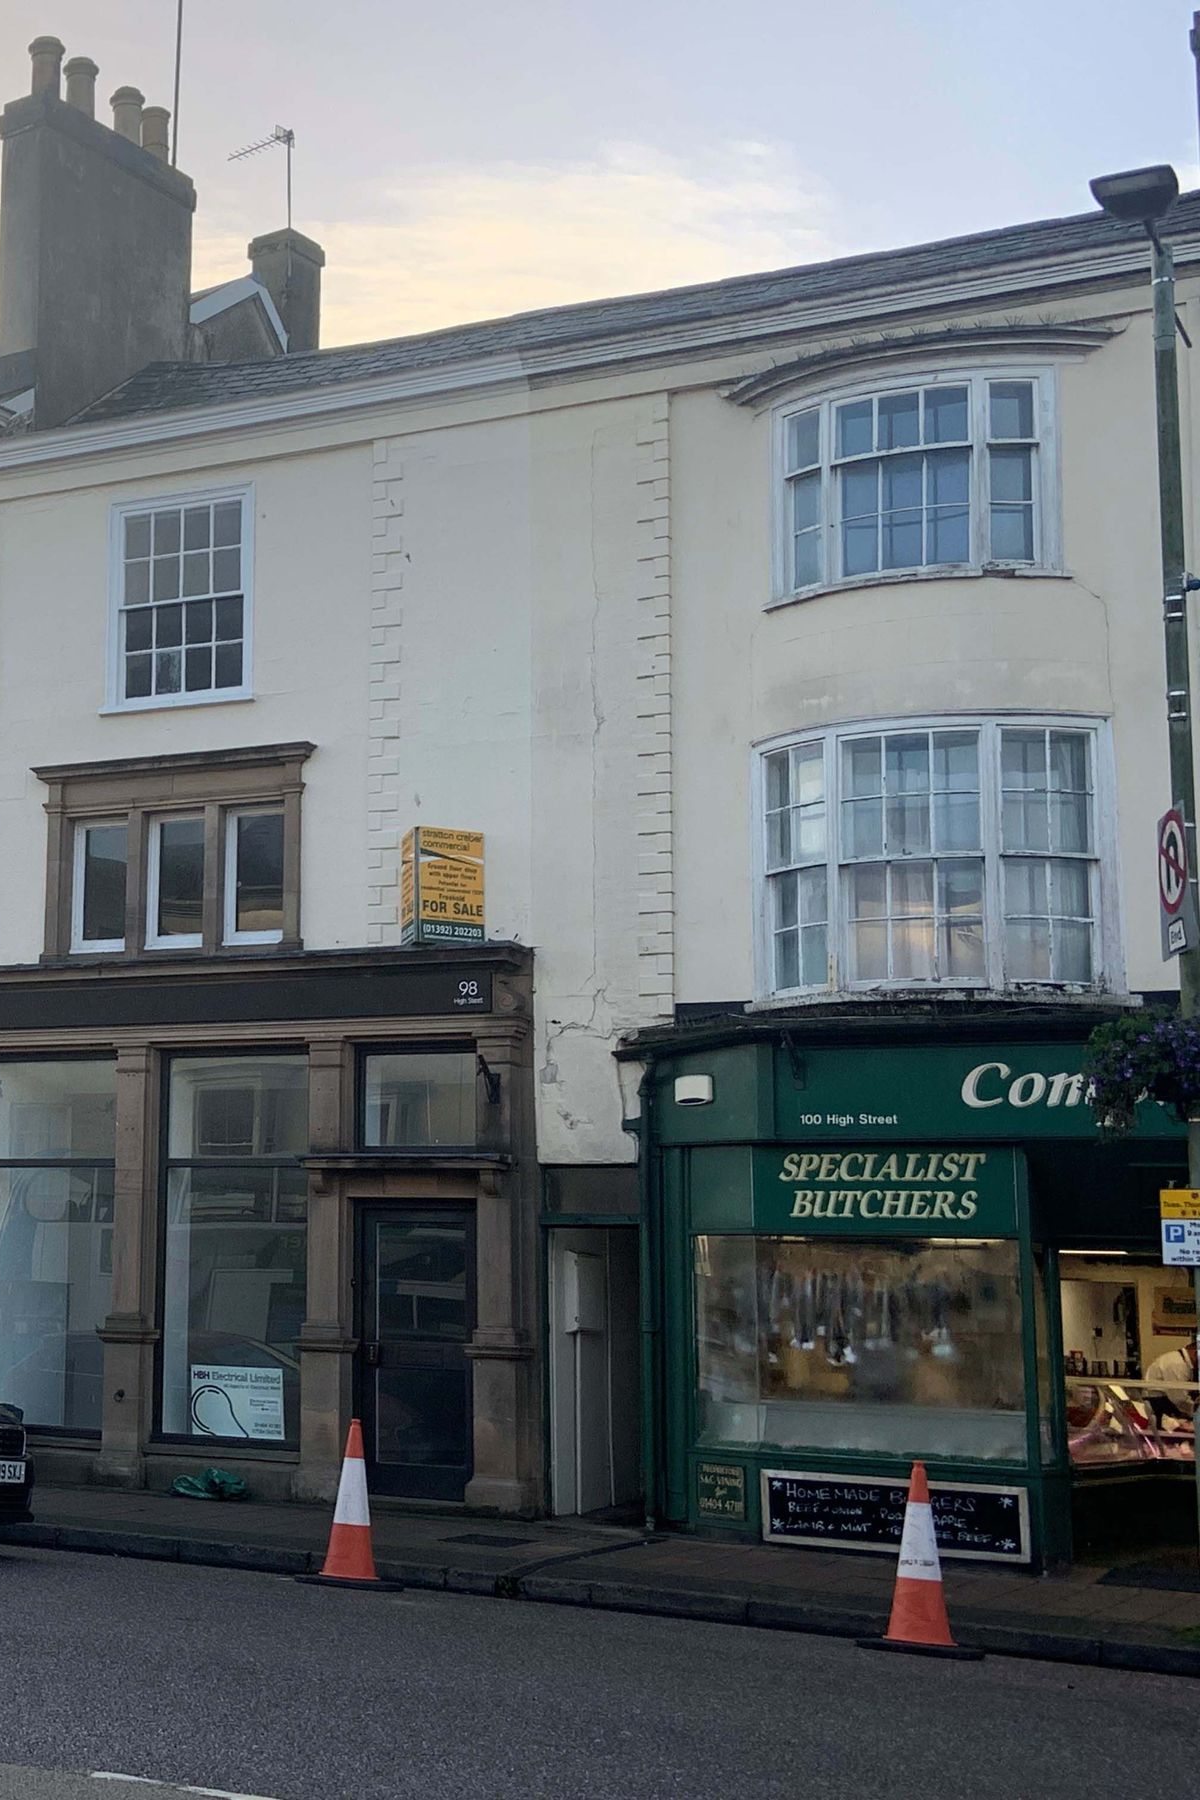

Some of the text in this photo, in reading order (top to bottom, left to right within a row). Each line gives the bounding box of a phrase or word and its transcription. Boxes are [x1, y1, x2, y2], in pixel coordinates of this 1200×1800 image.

[422, 830, 484, 842] stratton creber
[422, 840, 470, 851] commercial
[422, 900, 484, 917] FOR SALE
[423, 923, 482, 938] (01392) 202203
[459, 981, 478, 996] 98
[799, 1113, 898, 1127] 100 High Street
[779, 1153, 987, 1182] SPECIALIST
[790, 1189, 978, 1220] BUTCHERS
[1170, 1226, 1182, 1241] P
[212, 1371, 248, 1382] Electrical
[249, 1373, 281, 1385] Limited
